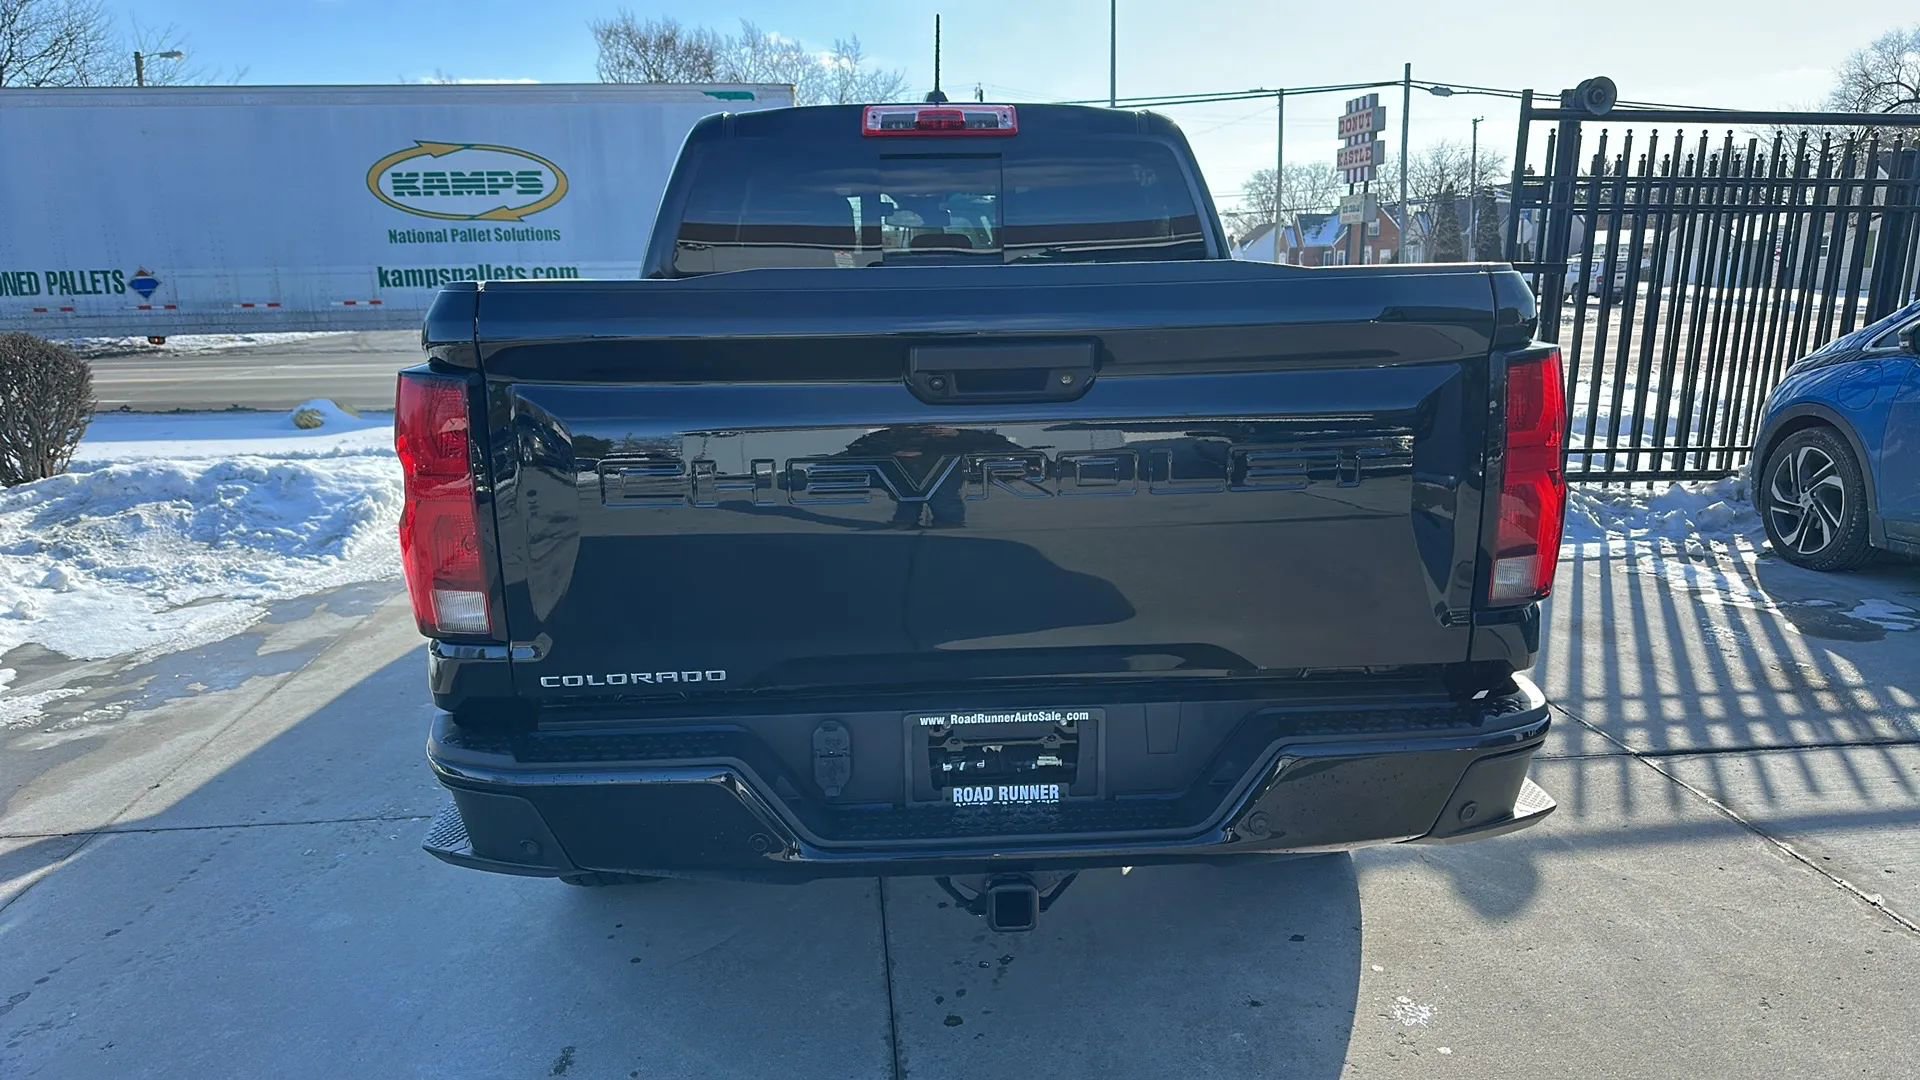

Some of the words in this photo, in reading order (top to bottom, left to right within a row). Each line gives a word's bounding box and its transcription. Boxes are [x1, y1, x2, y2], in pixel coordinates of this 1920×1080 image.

[1339, 112, 1372, 135] DONUT
[1337, 147, 1371, 168] KASTLE
[391, 170, 544, 197] KAMPS
[388, 228, 447, 245] National
[451, 228, 491, 243] Pallet
[494, 226, 561, 243] Solutions
[45, 269, 126, 296] PALLETS
[377, 264, 579, 289] kampspalletscom
[598, 438, 1392, 507] CHEVROLET
[540, 670, 727, 688] COLORADO
[920, 711, 1089, 726] wwwRoadRunnerAutoSalecom
[953, 787, 994, 802] ROAD
[999, 784, 1059, 801] RUNNER
